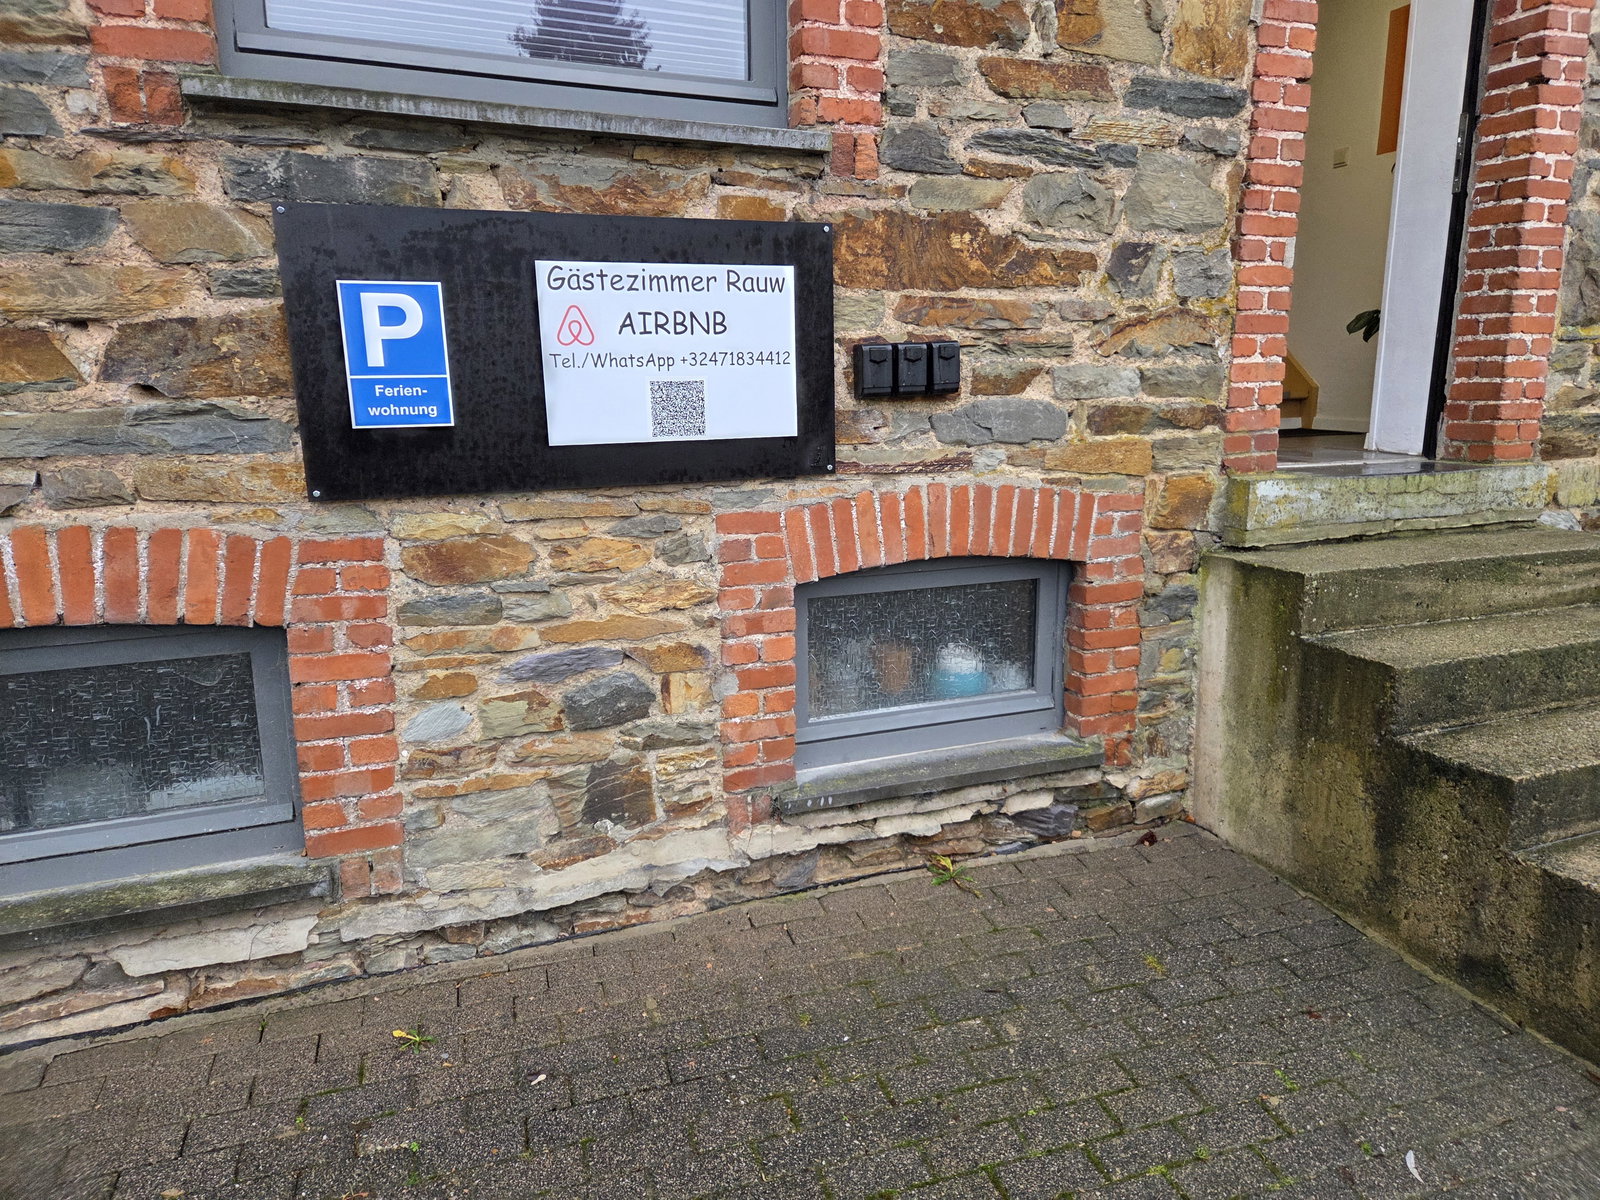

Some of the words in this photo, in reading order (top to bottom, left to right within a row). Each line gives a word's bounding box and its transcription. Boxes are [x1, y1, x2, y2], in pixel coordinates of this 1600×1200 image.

[547, 265, 717, 293] Gästezimmer
[726, 269, 785, 293] Rauw
[360, 292, 423, 367] P
[618, 310, 728, 336] AIRBNB
[549, 352, 675, 372] Tel./WhatsApp
[680, 350, 791, 367] +32471834412
[375, 384, 428, 397] Ferien-
[368, 404, 437, 417] wohnung
